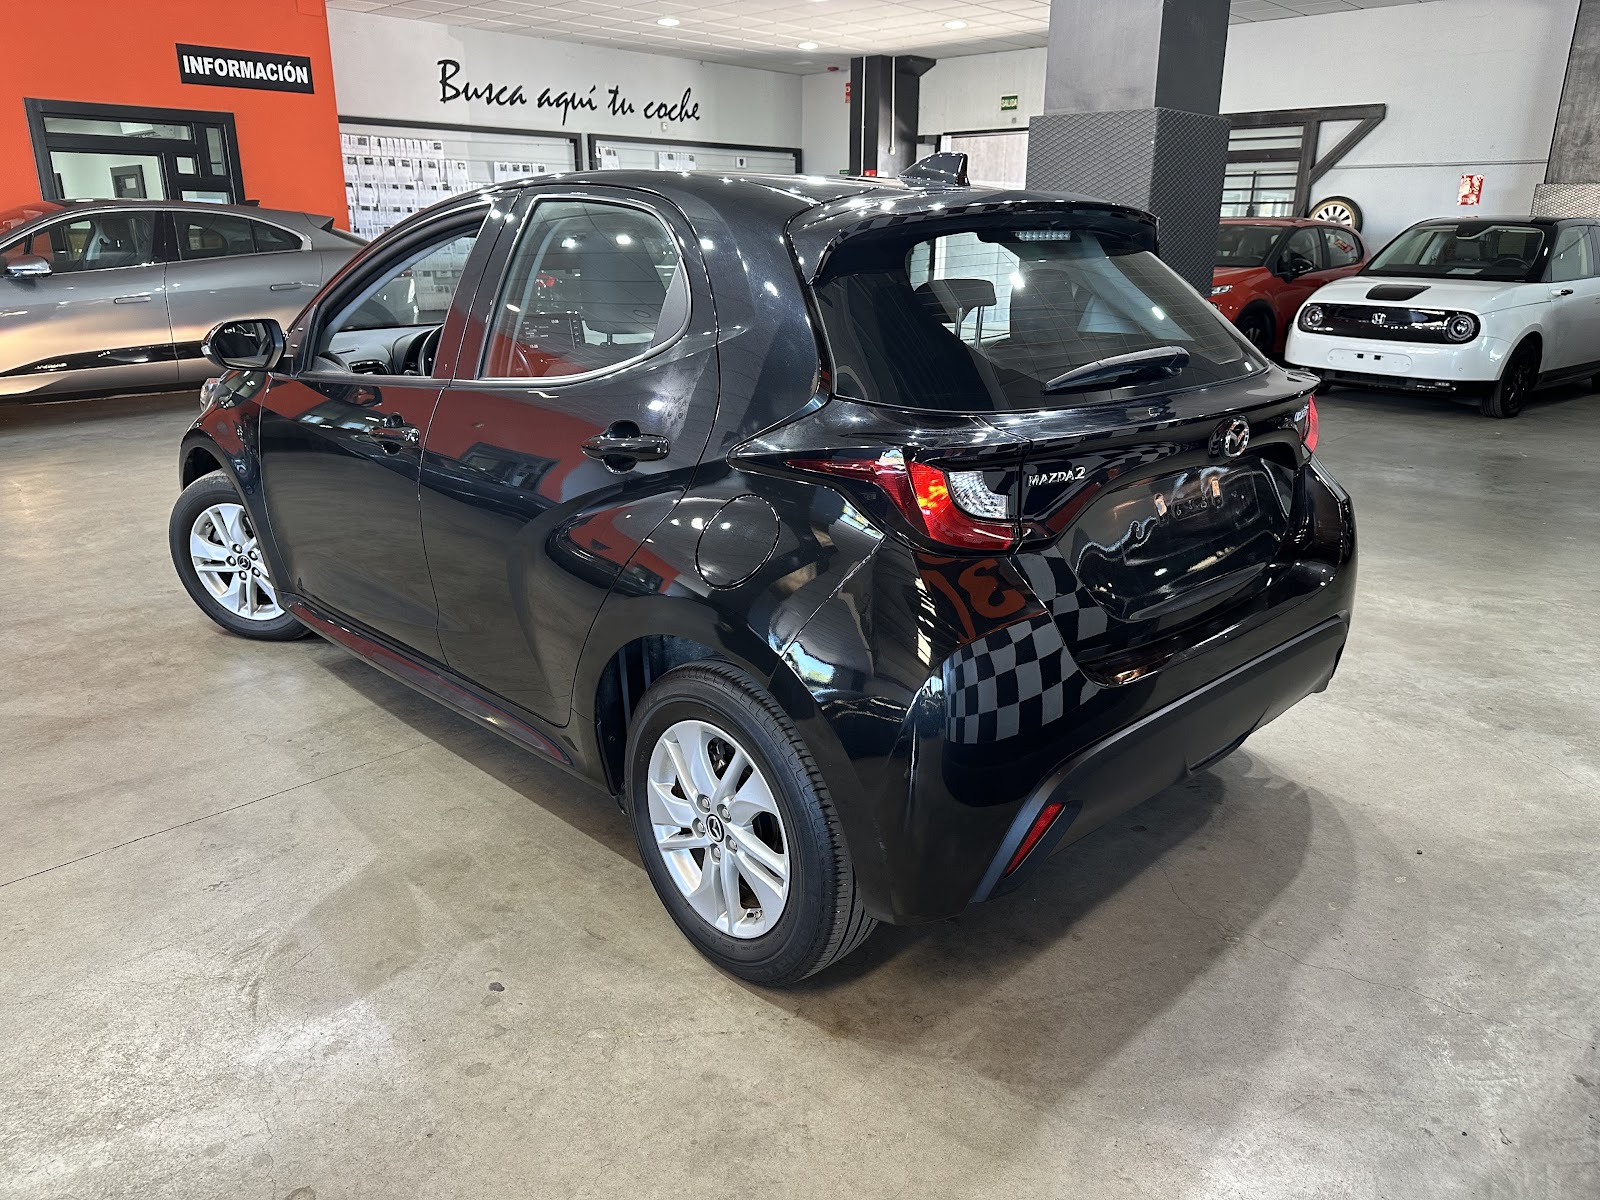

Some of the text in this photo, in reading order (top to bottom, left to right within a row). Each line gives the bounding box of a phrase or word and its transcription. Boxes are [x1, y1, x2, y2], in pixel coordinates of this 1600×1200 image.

[182, 54, 309, 84] INFORMACIÓN
[437, 59, 701, 126] Busca aquí tu coche
[1028, 466, 1086, 487] MAZDA2
